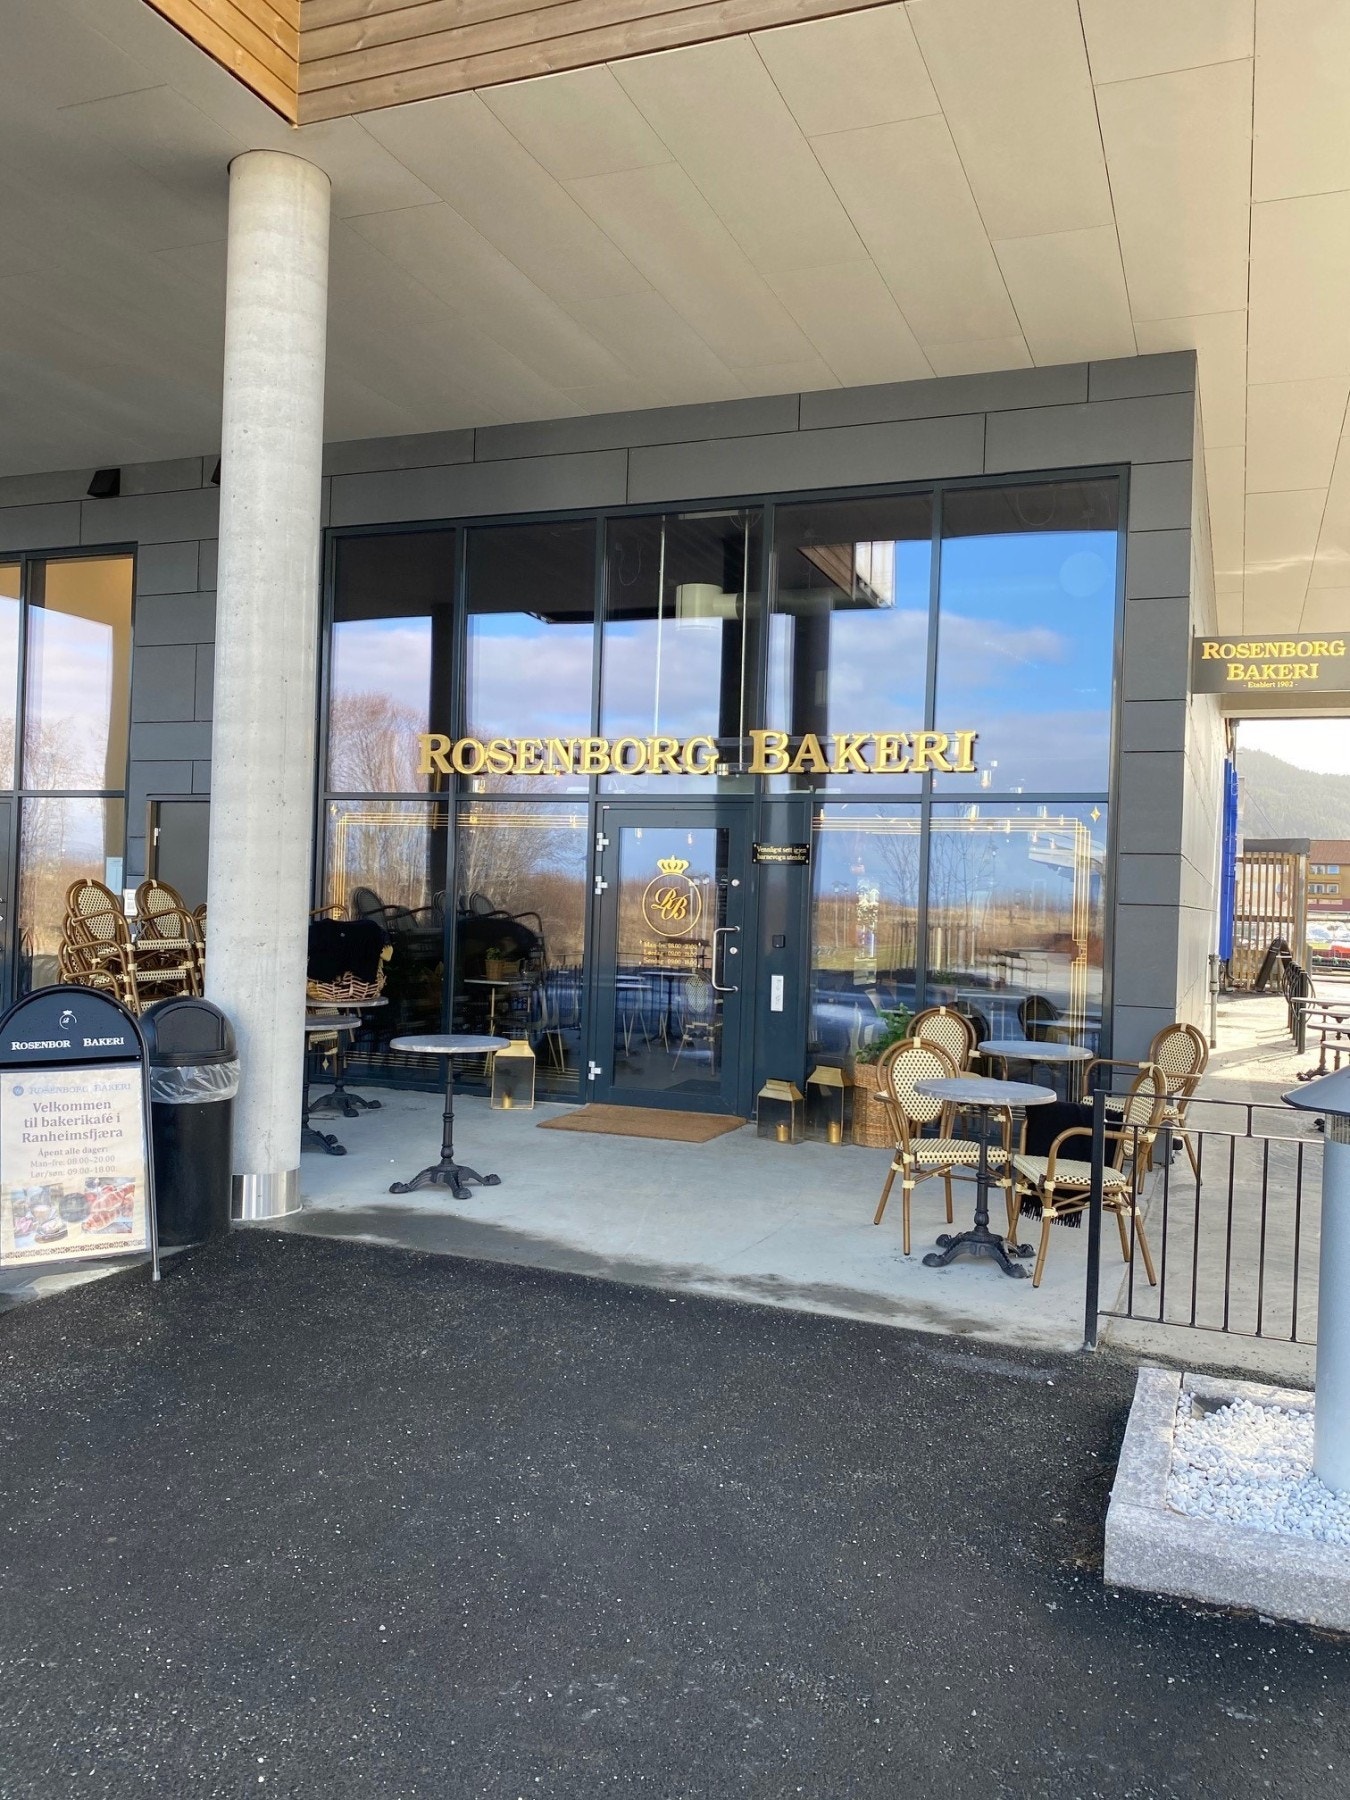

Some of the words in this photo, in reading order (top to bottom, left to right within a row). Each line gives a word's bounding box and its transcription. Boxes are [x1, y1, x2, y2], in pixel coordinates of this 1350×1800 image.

[1201, 640, 1347, 659] ROSENBORG
[1226, 663, 1319, 681] BAKERI
[416, 733, 720, 776] ROSENBORG
[748, 729, 978, 774] BAKERI
[83, 1037, 125, 1047] BAKERI
[94, 1083, 131, 1092] BAKERI
[33, 1101, 112, 1113] Velkommen
[24, 1117, 38, 1128] til
[41, 1113, 113, 1128] bakerikafé
[116, 1112, 121, 1123] i
[22, 1128, 123, 1143] Ranheimsfjæra
[38, 1147, 63, 1158] Åpent
[65, 1147, 80, 1155] alle
